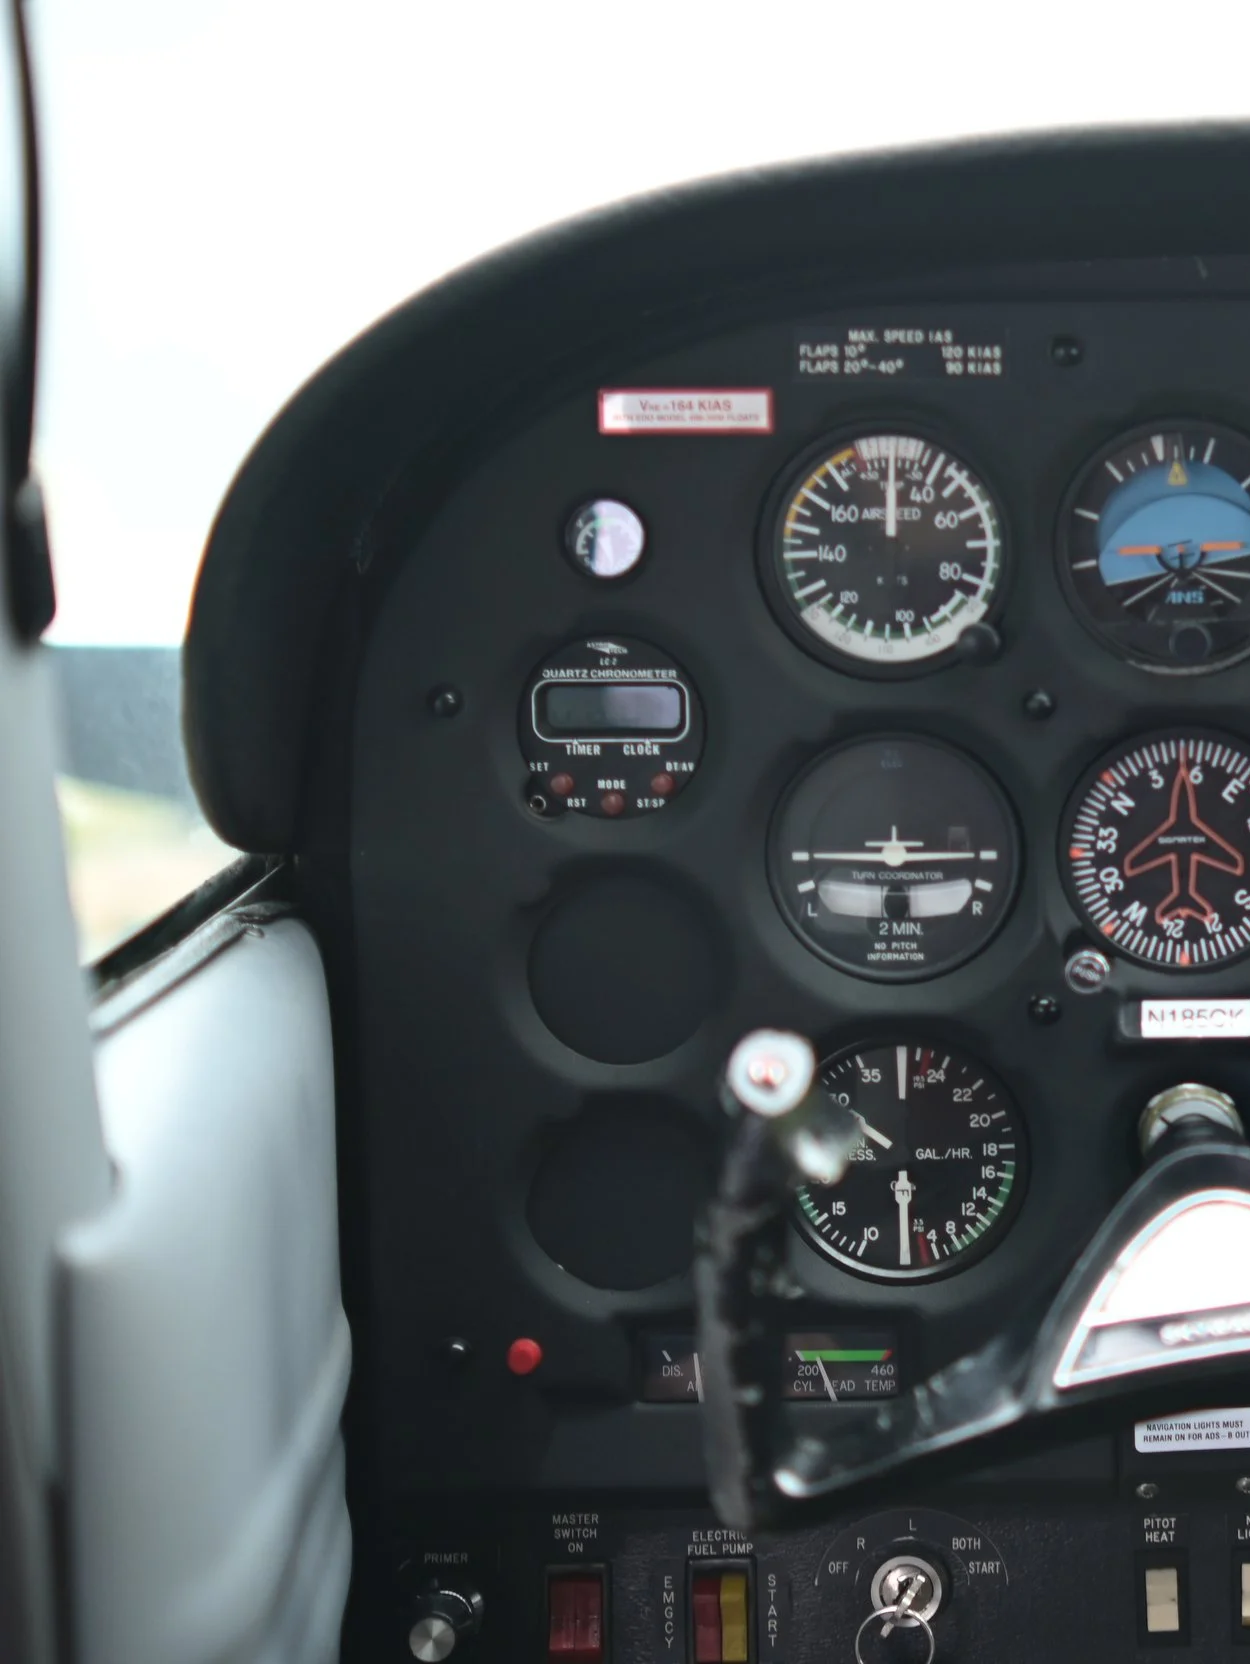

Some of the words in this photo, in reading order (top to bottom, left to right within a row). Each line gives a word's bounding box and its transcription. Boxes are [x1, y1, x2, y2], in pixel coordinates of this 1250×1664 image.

[848, 330, 879, 343] MAX.
[884, 330, 923, 344] SPEED
[929, 330, 952, 343] IAS
[800, 345, 838, 358] FLAPS
[941, 346, 962, 359] 120
[968, 346, 1001, 359] KIAS
[800, 360, 838, 373] FLAPS
[946, 362, 962, 374] 90
[968, 361, 1001, 374] KIAS
[910, 487, 934, 503] 40
[831, 505, 858, 522] 160
[939, 562, 961, 580] 80
[542, 669, 588, 679] QUARTZ
[590, 669, 677, 679] CHRONOMETER
[566, 744, 600, 755] TIMER
[623, 744, 660, 755] CLOCK
[597, 779, 626, 790] MODE
[1221, 778, 1245, 803] E
[1110, 791, 1136, 816] N
[1096, 826, 1119, 853] 33
[852, 871, 876, 880] TURN
[878, 871, 943, 880] COORDINATOR
[879, 921, 889, 935] 2
[892, 921, 924, 936] MIN.
[874, 942, 887, 950] NO
[891, 942, 917, 950] PITCH
[867, 952, 924, 961] INFORMATION
[861, 1069, 881, 1083] 35
[952, 1088, 973, 1102] 22
[915, 1148, 973, 1160] GAL./HR.
[982, 1143, 997, 1156] 18
[797, 1364, 819, 1376] 200
[793, 1380, 815, 1392] CYL
[864, 1379, 895, 1392] TEMP
[1146, 1422, 1191, 1431] NAVIGATION
[1193, 1421, 1220, 1430] LIGHTS
[1222, 1420, 1243, 1428] MUST
[552, 1514, 599, 1525] MASTER
[1144, 1518, 1176, 1529] PITOT
[554, 1528, 597, 1539] SWITCH
[1145, 1531, 1175, 1543] HEAT
[567, 1542, 583, 1553] ON
[688, 1544, 717, 1556] FUEL
[722, 1542, 753, 1555] PUMP
[952, 1537, 981, 1550] BOTH
[424, 1552, 468, 1564] PRIMER
[828, 1562, 848, 1574] OFF
[968, 1562, 1000, 1574] START
[767, 1574, 778, 1647] START
